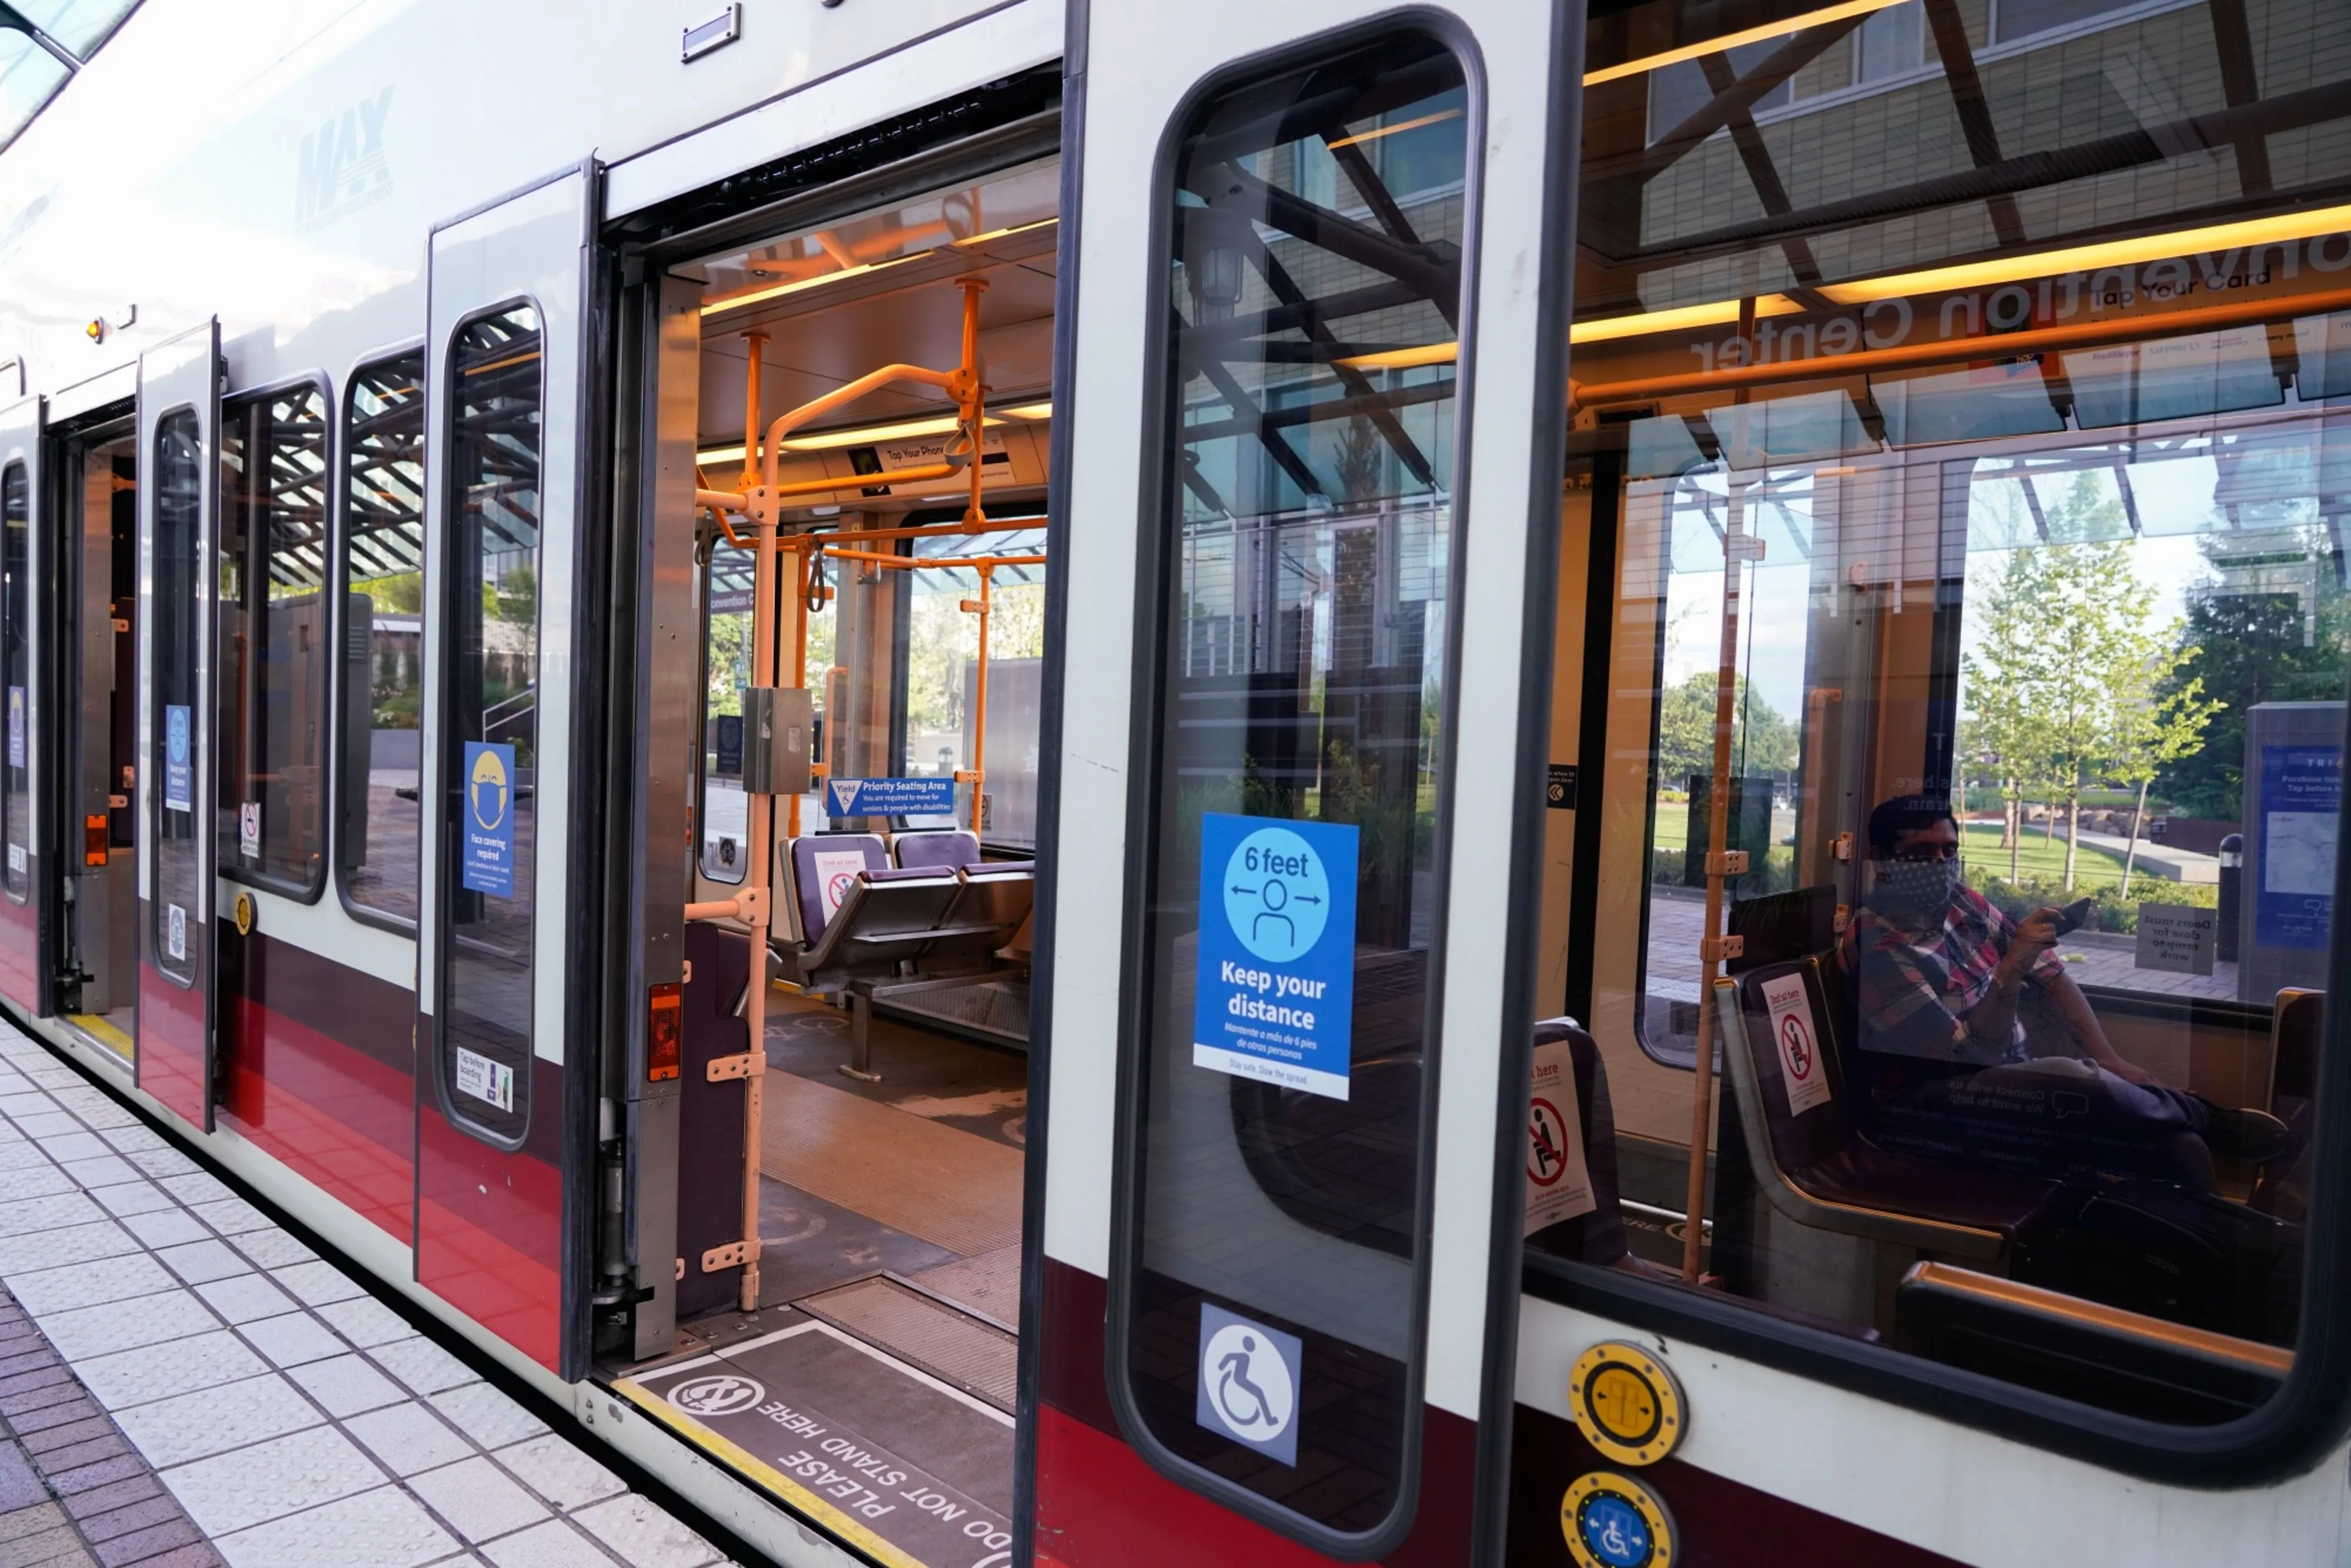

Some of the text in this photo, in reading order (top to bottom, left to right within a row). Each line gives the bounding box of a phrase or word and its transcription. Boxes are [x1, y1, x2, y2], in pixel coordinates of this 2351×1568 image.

[294, 82, 397, 224] MAX
[2092, 263, 2271, 309] Tap Your Card
[887, 450, 902, 462] Tap
[902, 448, 920, 458] Your
[836, 784, 856, 793] Yield
[863, 782, 947, 793] Priority Seating Area
[885, 793, 908, 803] required
[890, 804, 908, 812] people
[1245, 846, 1308, 877] 6 feet
[1221, 960, 1326, 999] Keep your
[1228, 993, 1315, 1030] distance
[1224, 1021, 1317, 1050] Mantente a más de 6 pies
[1237, 1037, 1302, 1060] de otras personas
[1536, 1064, 1558, 1077] here
[758, 1401, 1012, 1550] DO NOT STAND HERE
[778, 1450, 896, 1519] PLEASE
